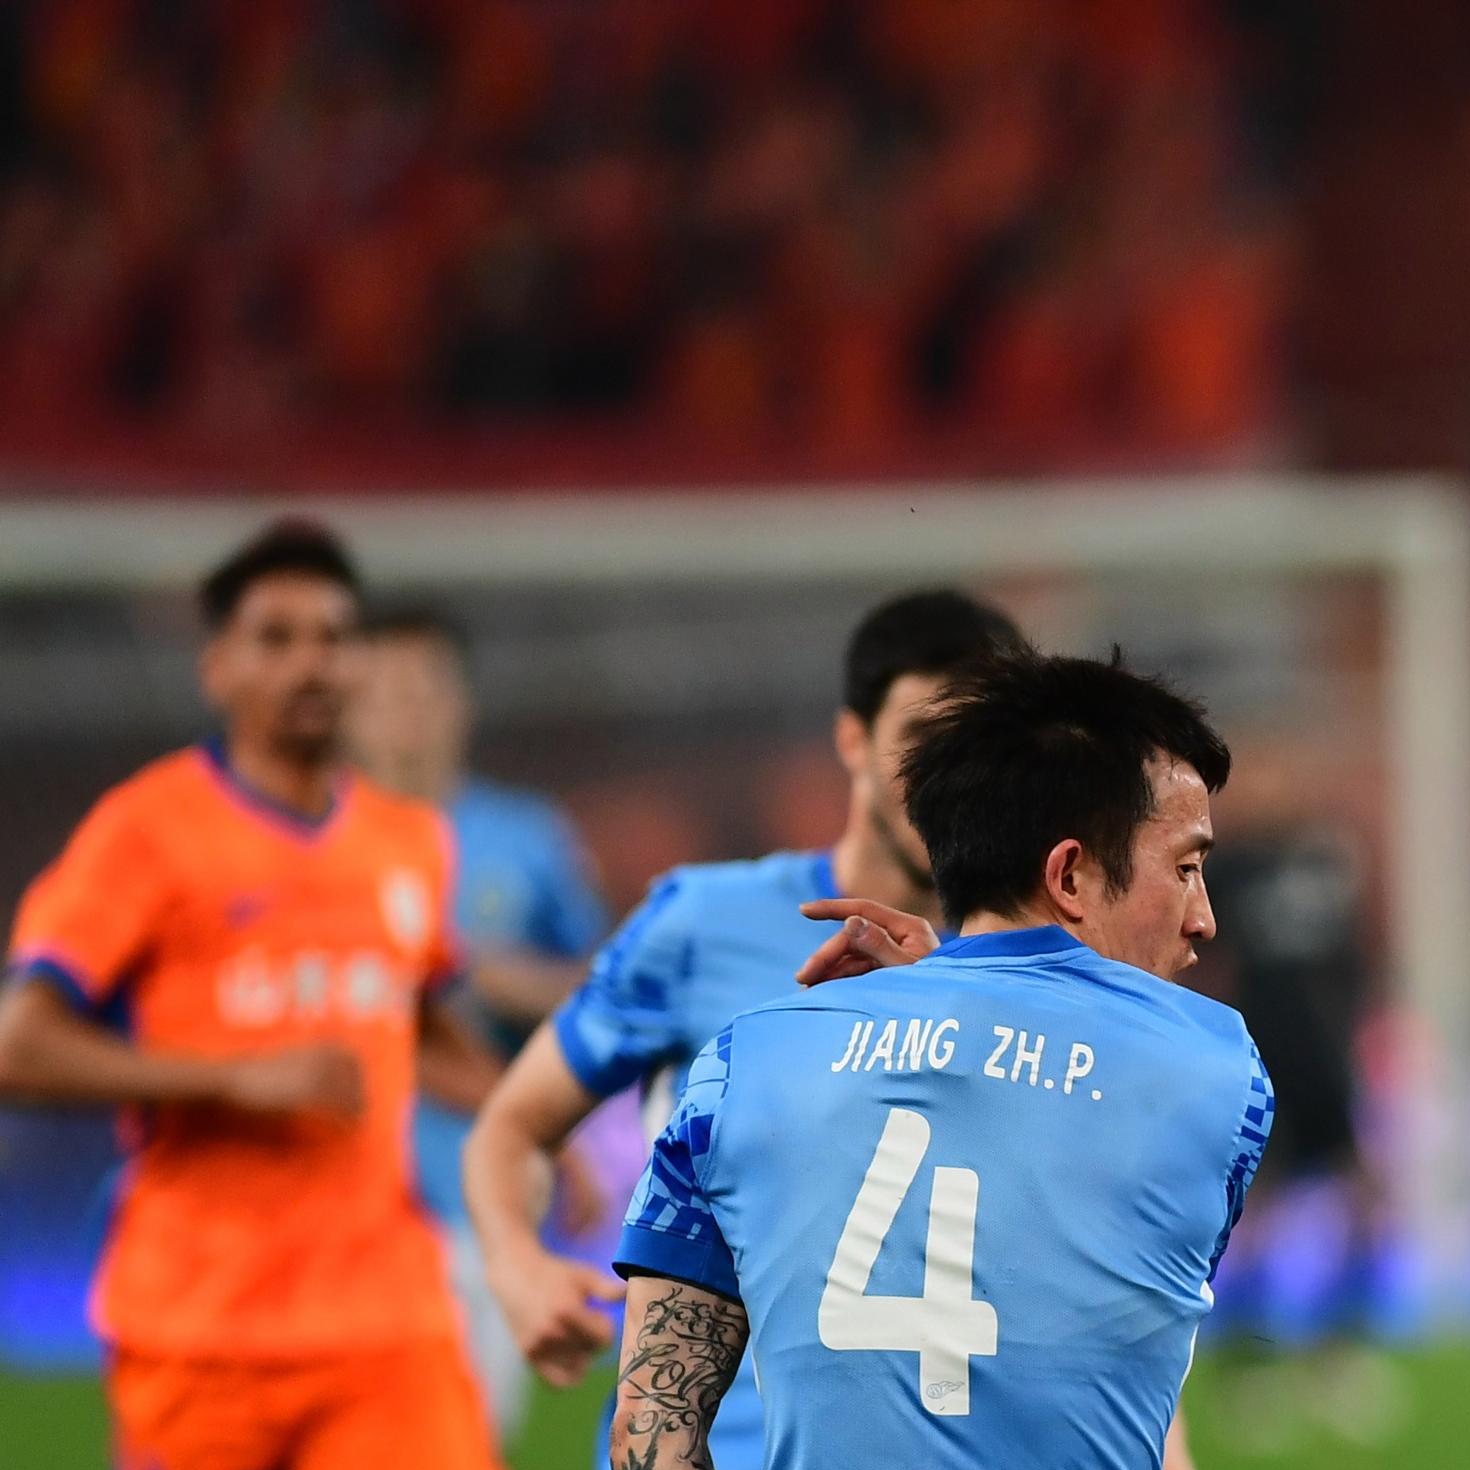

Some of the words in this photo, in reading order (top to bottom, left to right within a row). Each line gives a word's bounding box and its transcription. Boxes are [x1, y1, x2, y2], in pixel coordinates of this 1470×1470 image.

[830, 1018, 960, 1073] JIANG
[983, 1024, 1102, 1101] ZH.P.
[817, 1107, 999, 1416] 4
